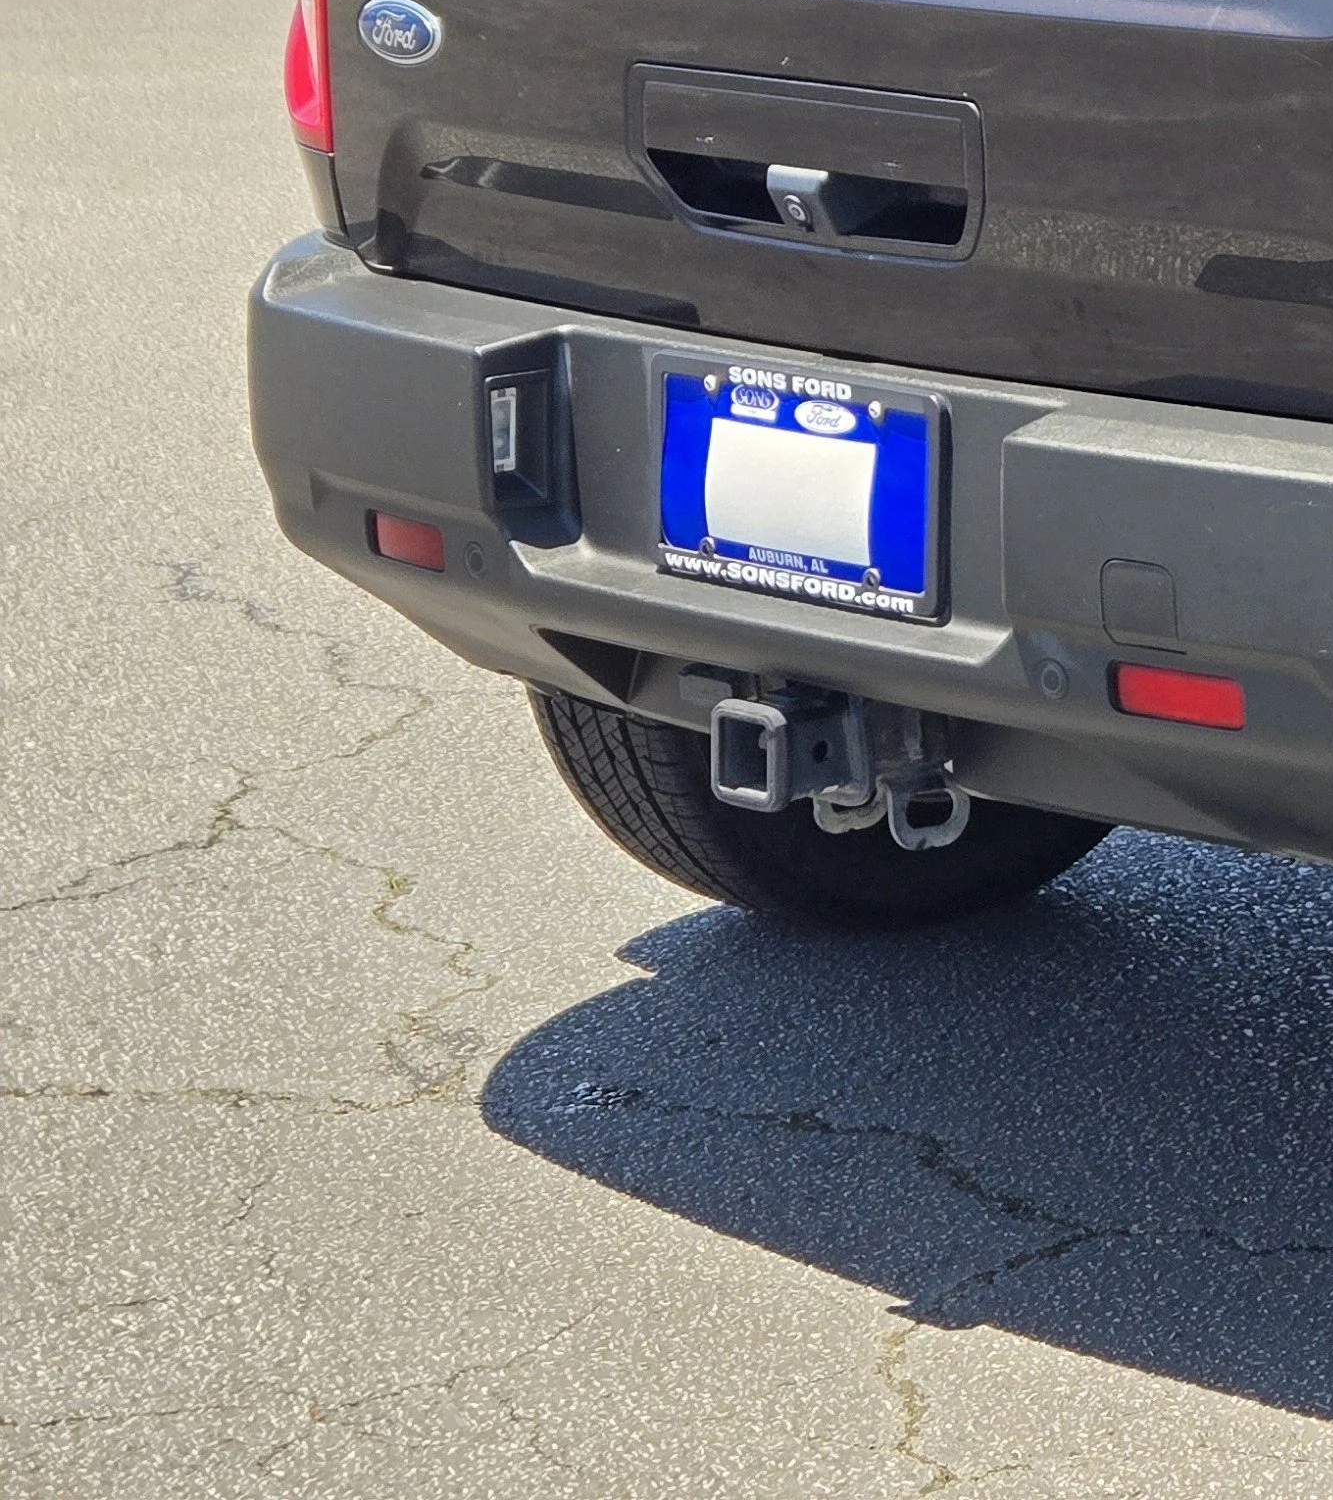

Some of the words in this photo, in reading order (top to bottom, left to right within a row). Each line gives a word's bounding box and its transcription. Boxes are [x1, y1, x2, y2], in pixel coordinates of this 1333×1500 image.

[728, 366, 787, 390] SONS
[792, 376, 852, 400] FORD
[737, 388, 773, 409] SONS
[748, 546, 808, 572] AUBURN,
[811, 560, 829, 574] AL
[665, 552, 914, 613] www.SONSFORD.com
